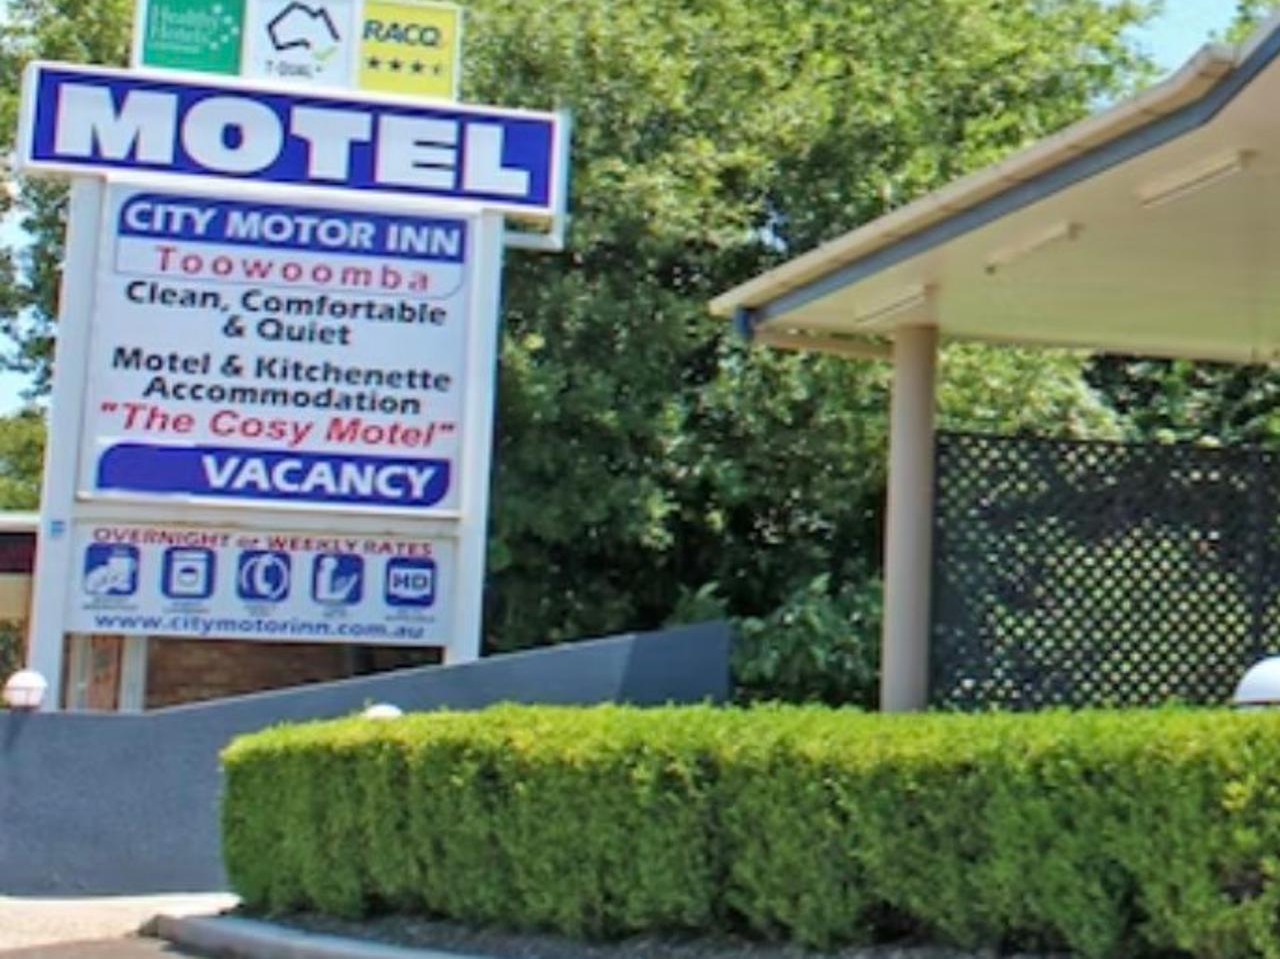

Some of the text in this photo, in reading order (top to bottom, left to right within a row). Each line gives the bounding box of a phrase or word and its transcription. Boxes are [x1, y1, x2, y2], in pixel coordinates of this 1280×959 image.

[362, 19, 442, 48] RACQ
[54, 83, 531, 197] MOTEL
[125, 201, 462, 256] CITY MOTOR INN
[156, 244, 429, 291] Toowoomba
[125, 280, 447, 326] Clean, Comfortable
[222, 314, 351, 346] & Quiet
[112, 345, 452, 392] Motel & Kitchenette
[142, 375, 421, 415] Accommodation
[100, 401, 455, 448] "The Cosy Motel"
[201, 453, 437, 499] VACANCY
[93, 527, 231, 547] OVERNIGHT
[268, 535, 360, 553] WEEKLY
[363, 541, 433, 556] RATES
[392, 572, 429, 591] HD
[94, 614, 425, 640] www.citymotorinn.com.au
